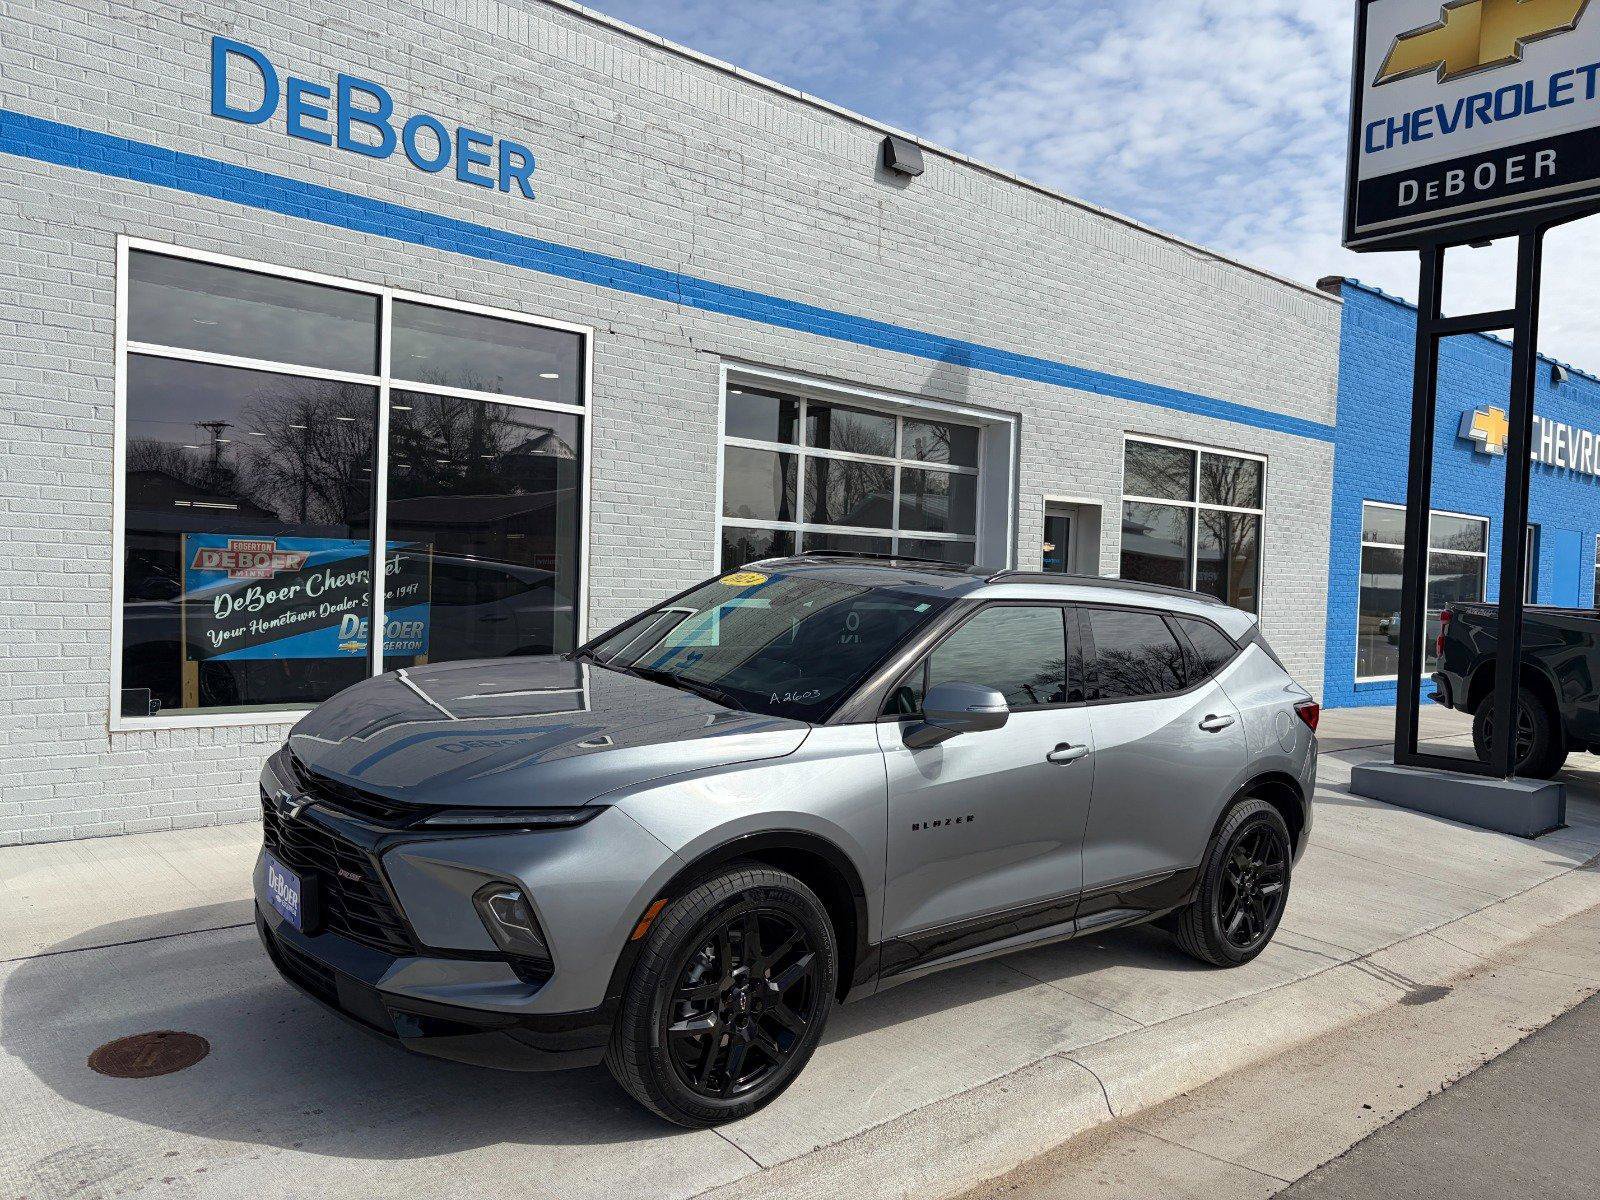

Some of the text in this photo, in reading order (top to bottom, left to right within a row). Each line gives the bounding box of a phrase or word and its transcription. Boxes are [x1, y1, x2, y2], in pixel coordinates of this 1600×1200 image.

[1365, 62, 1600, 154] CHEVROLET
[206, 627, 247, 648] Your
[248, 610, 318, 635] Hometown
[320, 596, 359, 618] Dealer
[396, 582, 419, 598] 1947
[213, 554, 410, 620] DeBoer Chevret
[911, 814, 975, 832] BLAZER
